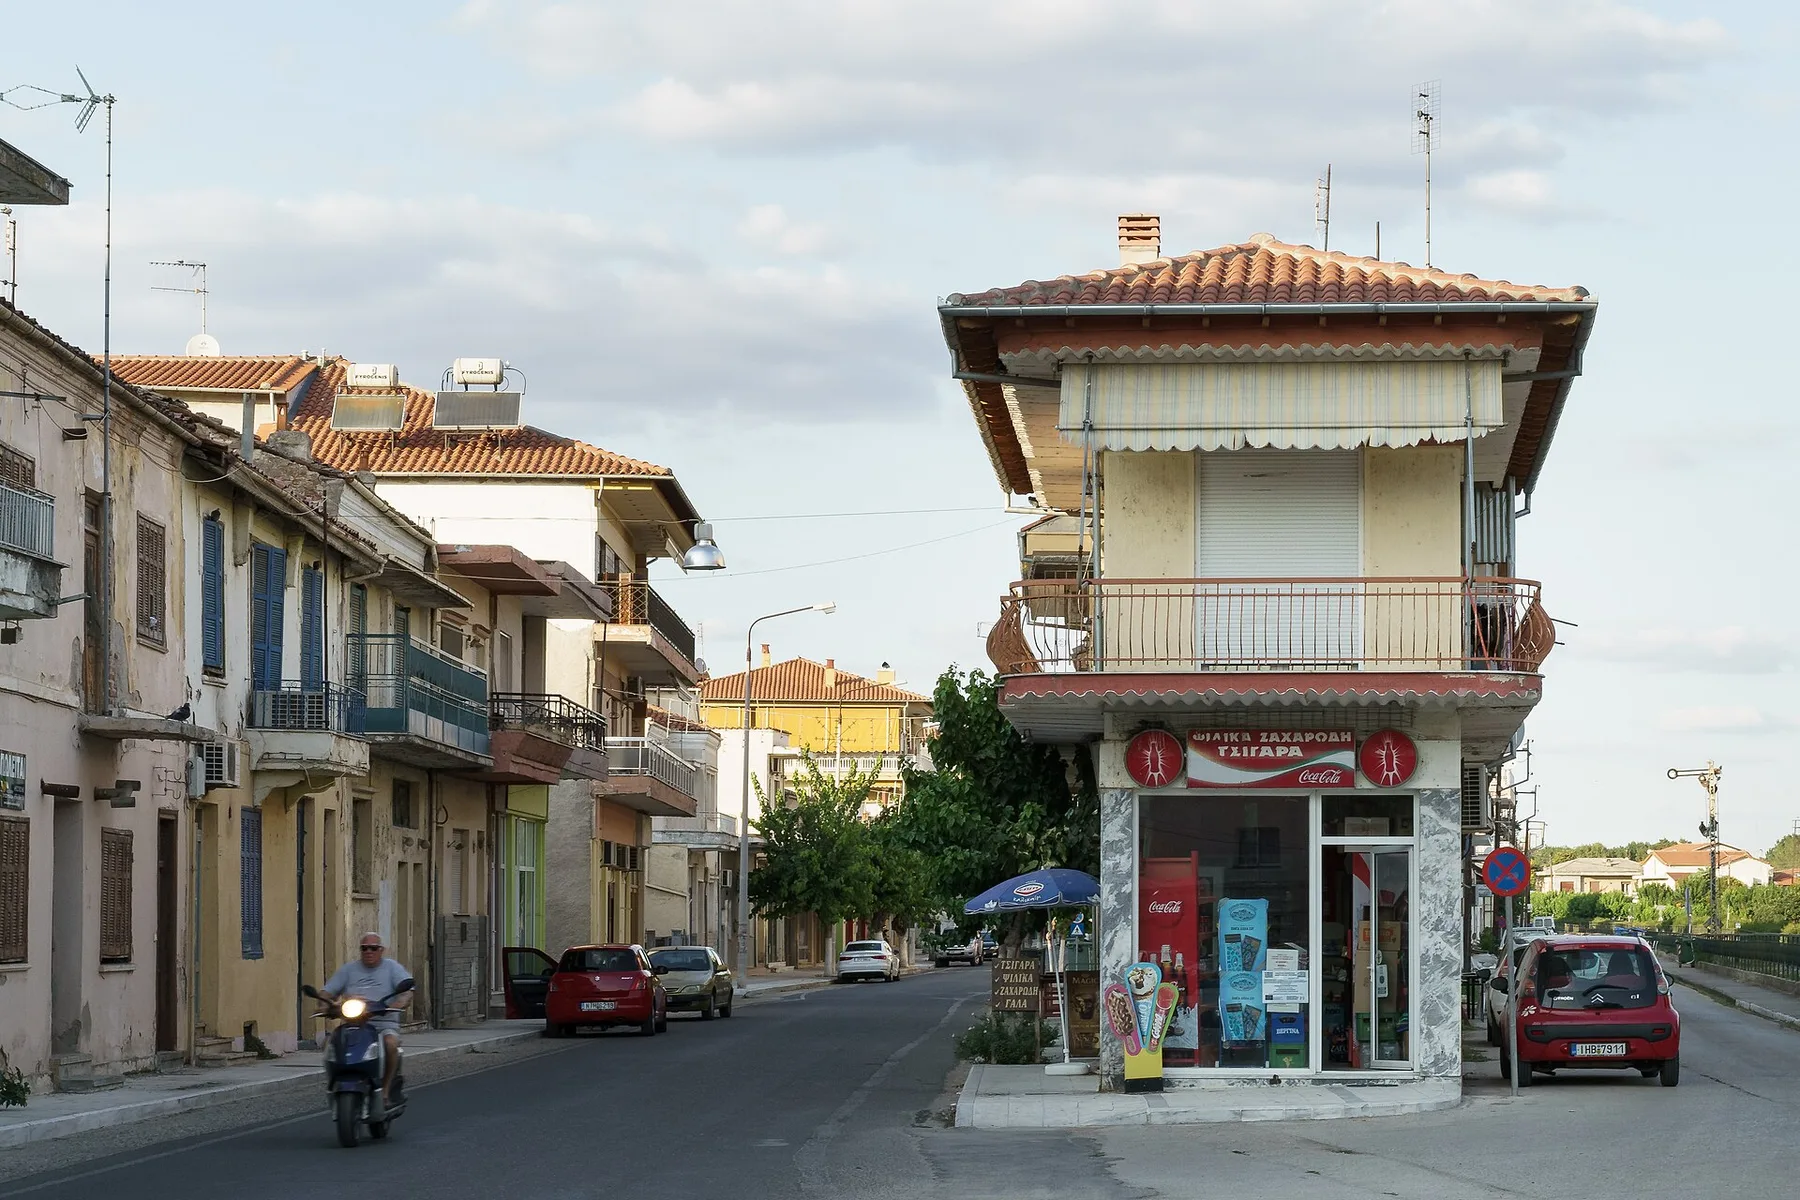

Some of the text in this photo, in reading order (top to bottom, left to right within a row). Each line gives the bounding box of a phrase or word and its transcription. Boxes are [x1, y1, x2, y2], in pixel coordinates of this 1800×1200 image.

[1217, 745, 1304, 758] ΤΣΙΓΑΡΑ
[1000, 960, 1035, 970] ΤΣΙΓΑΡΑ
[999, 986, 1039, 996] ΖΑΧΑΡΩΔΗ
[1005, 999, 1028, 1009] ΓΑΛΑ
